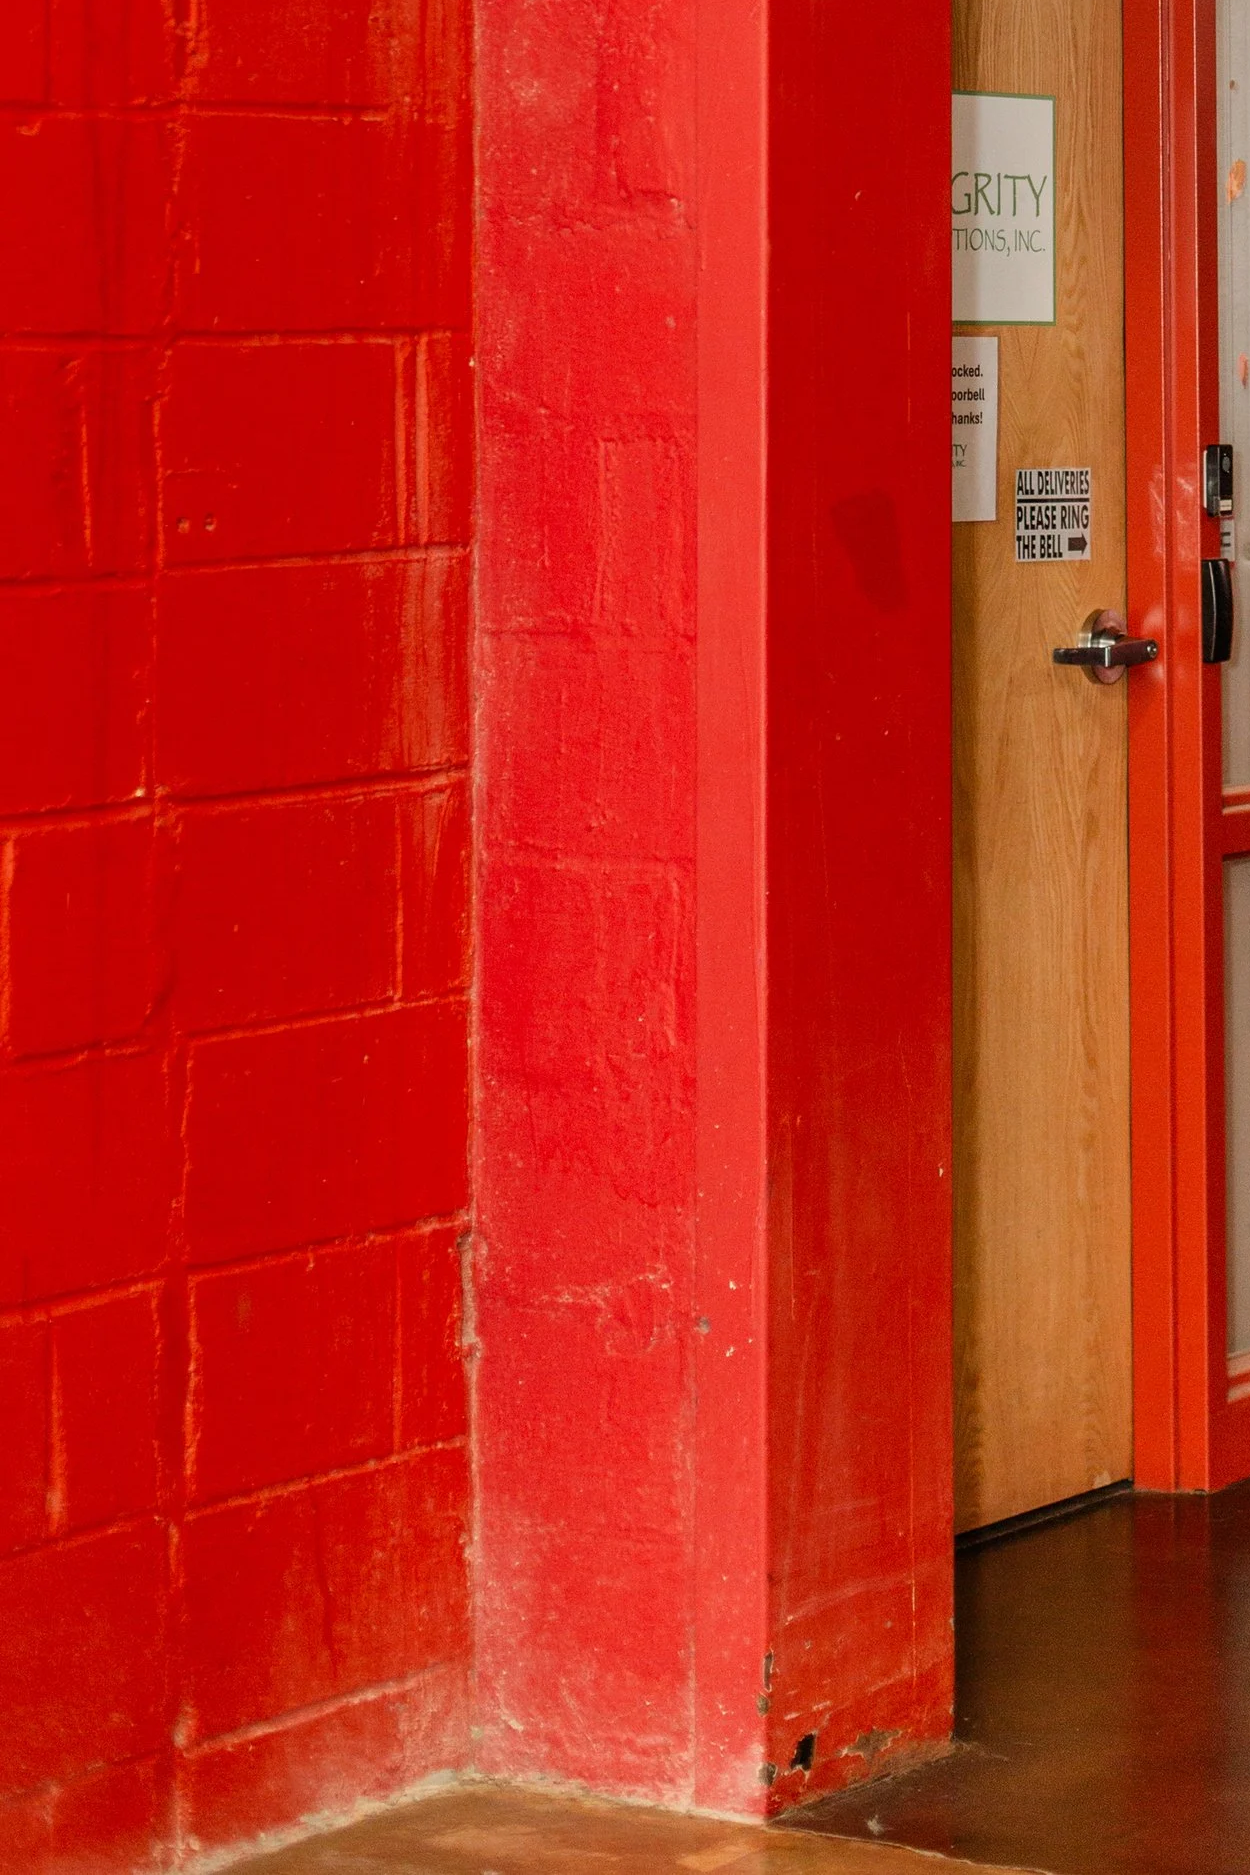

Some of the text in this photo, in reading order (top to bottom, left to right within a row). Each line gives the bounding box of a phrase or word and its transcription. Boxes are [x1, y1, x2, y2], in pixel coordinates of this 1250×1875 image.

[1014, 229, 1046, 253] INC.
[1017, 470, 1090, 495] ALL DELIVERIES
[1016, 504, 1090, 531] PLEASE RING
[1016, 534, 1063, 559] THE BELL
